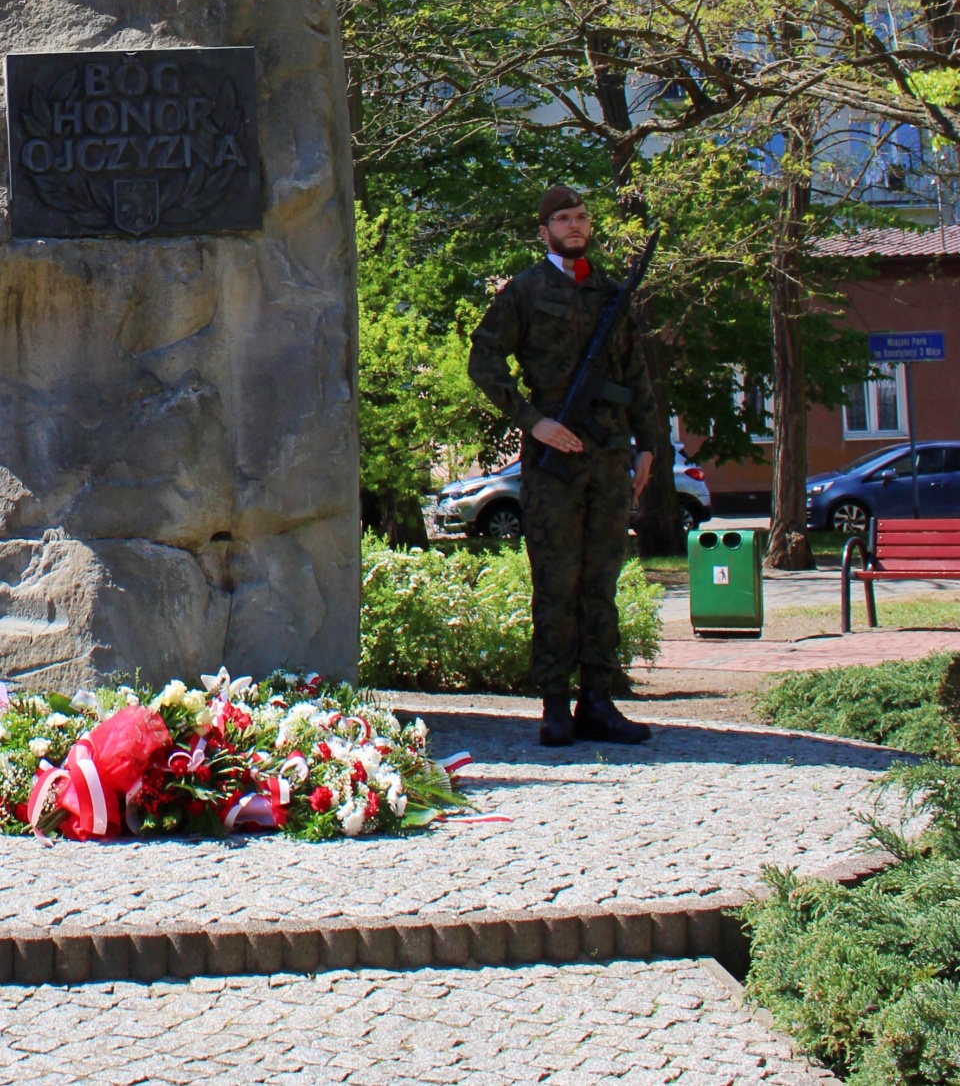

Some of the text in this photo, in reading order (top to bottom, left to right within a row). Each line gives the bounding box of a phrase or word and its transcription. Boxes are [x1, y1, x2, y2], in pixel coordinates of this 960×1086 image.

[54, 97, 224, 135] HONOR
[21, 134, 247, 173] OJCZYZNA
[912, 337, 928, 346] Park
[926, 347, 941, 357] Maja
